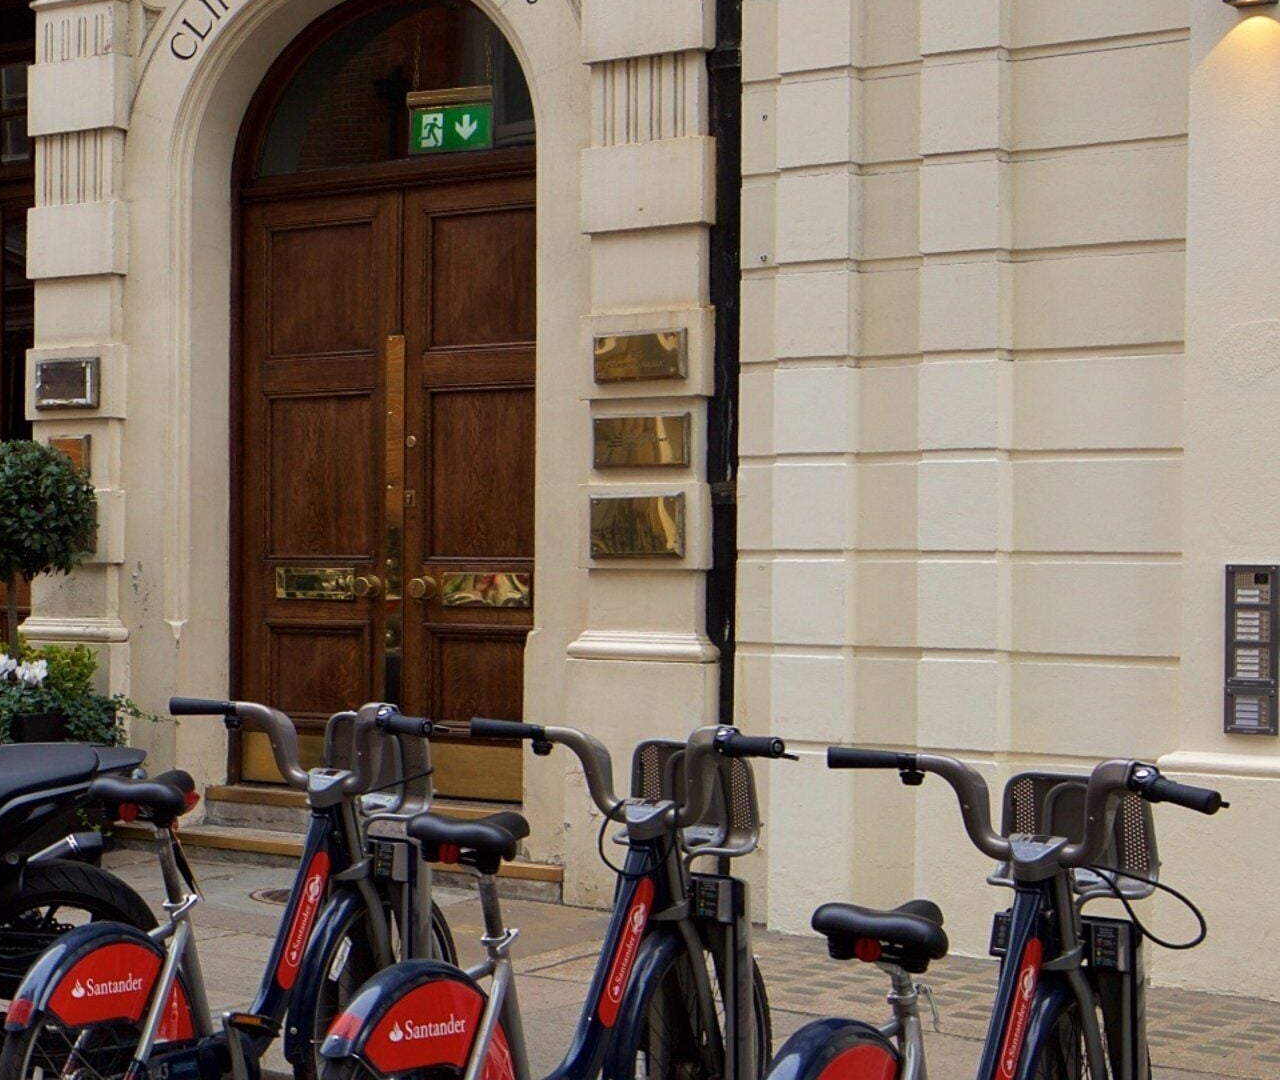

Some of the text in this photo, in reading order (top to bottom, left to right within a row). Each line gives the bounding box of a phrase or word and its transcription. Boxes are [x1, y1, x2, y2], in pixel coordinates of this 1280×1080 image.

[293, 904, 313, 953] Santander
[613, 933, 637, 985] Santander
[87, 972, 144, 997] Santander
[404, 1013, 466, 1041] Santander
[1008, 1003, 1028, 1059] Santander
